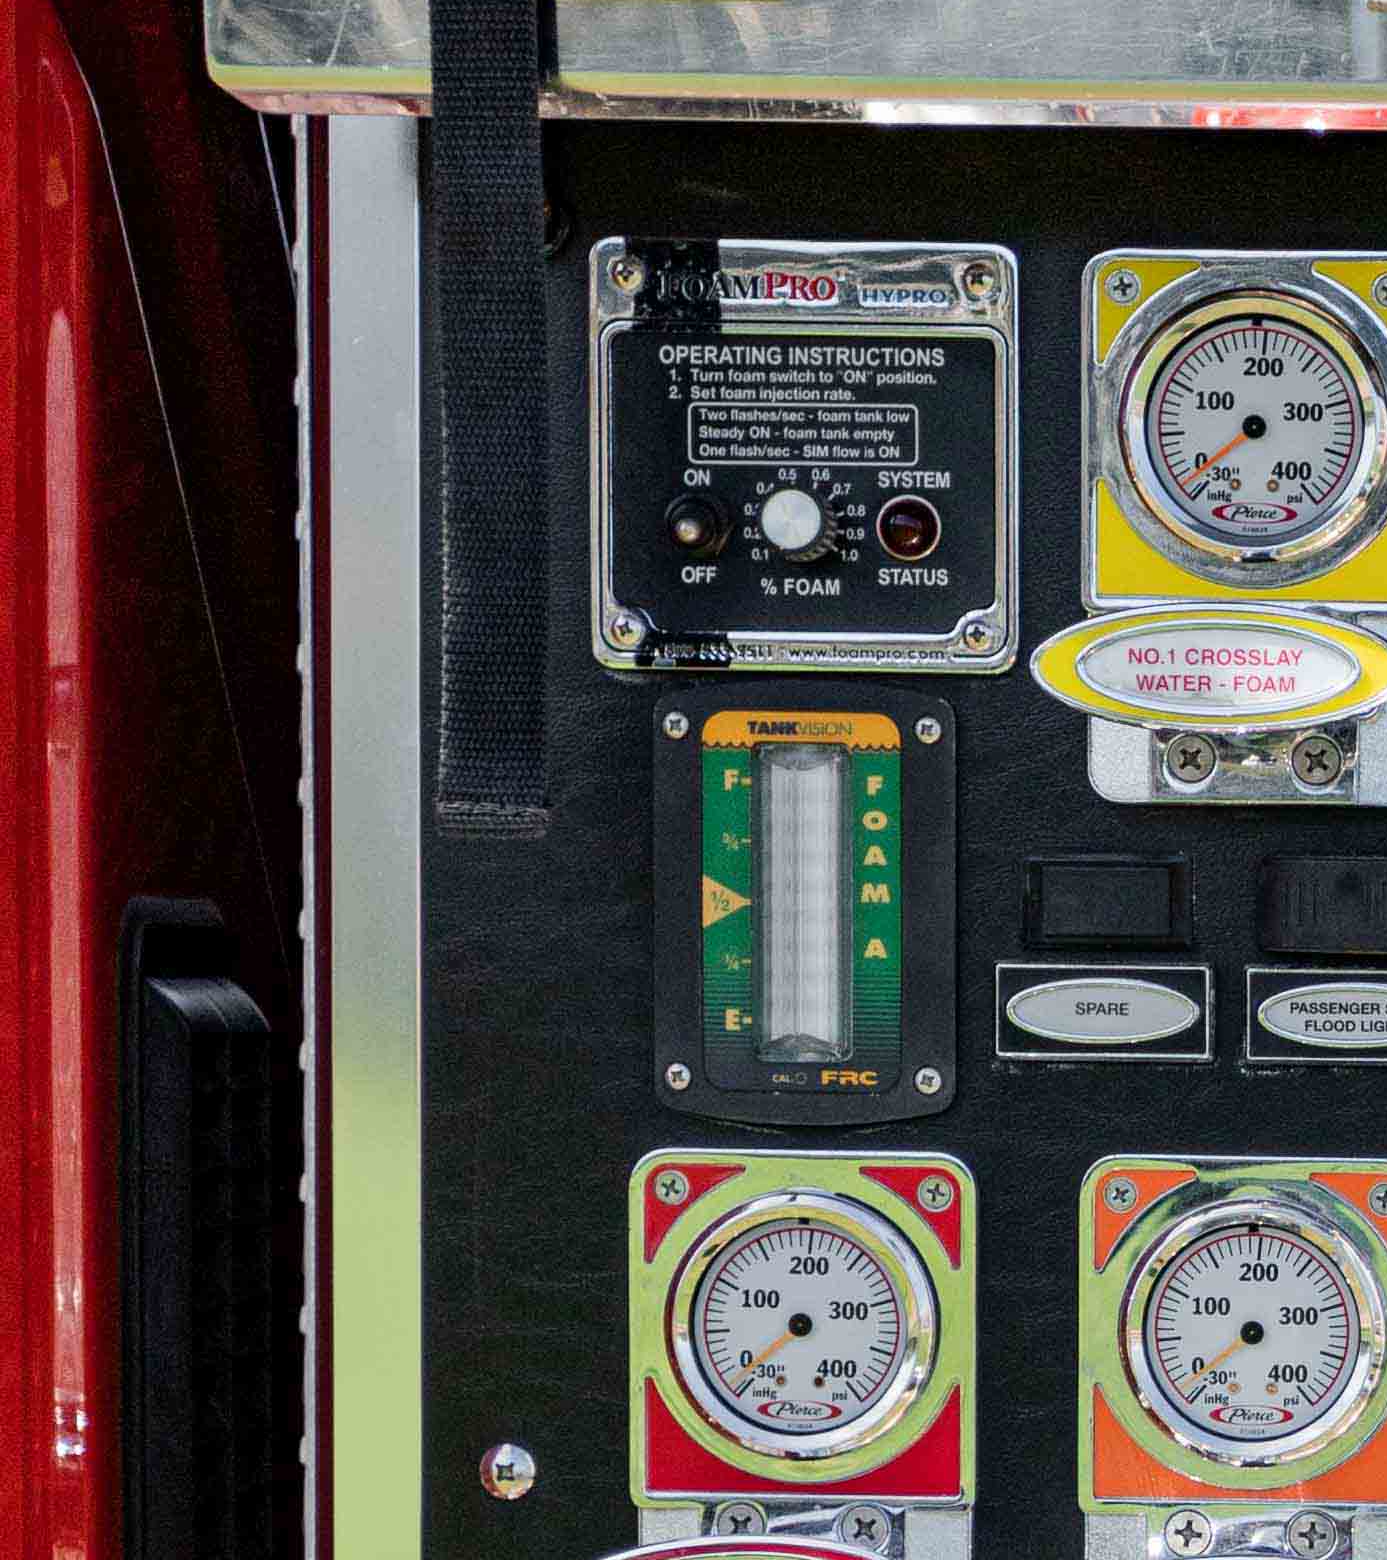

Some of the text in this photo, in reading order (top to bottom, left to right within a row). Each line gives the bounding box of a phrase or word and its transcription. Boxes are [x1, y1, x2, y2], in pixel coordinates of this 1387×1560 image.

[659, 345, 944, 366] OPERATING INSTRUCTIONS
[1243, 356, 1284, 378] 200
[670, 370, 681, 383] 1.
[690, 368, 724, 383] Turn
[728, 369, 765, 383] foam
[770, 370, 815, 383] switch
[819, 371, 833, 383] to
[877, 370, 936, 386] position.
[669, 386, 855, 403] 2. Set foam injection rate.
[1195, 391, 1235, 410] 100
[1283, 401, 1324, 422] 300
[684, 469, 710, 486] ON
[878, 471, 950, 488] SYSTEM
[1271, 460, 1312, 482] 400
[682, 566, 716, 583] OFF
[878, 568, 948, 585] STATUS
[784, 579, 840, 595] FOAM
[1076, 1002, 1128, 1016] SPARE
[1290, 1002, 1380, 1014] PASSENGER
[1305, 1020, 1356, 1032] FLOOD
